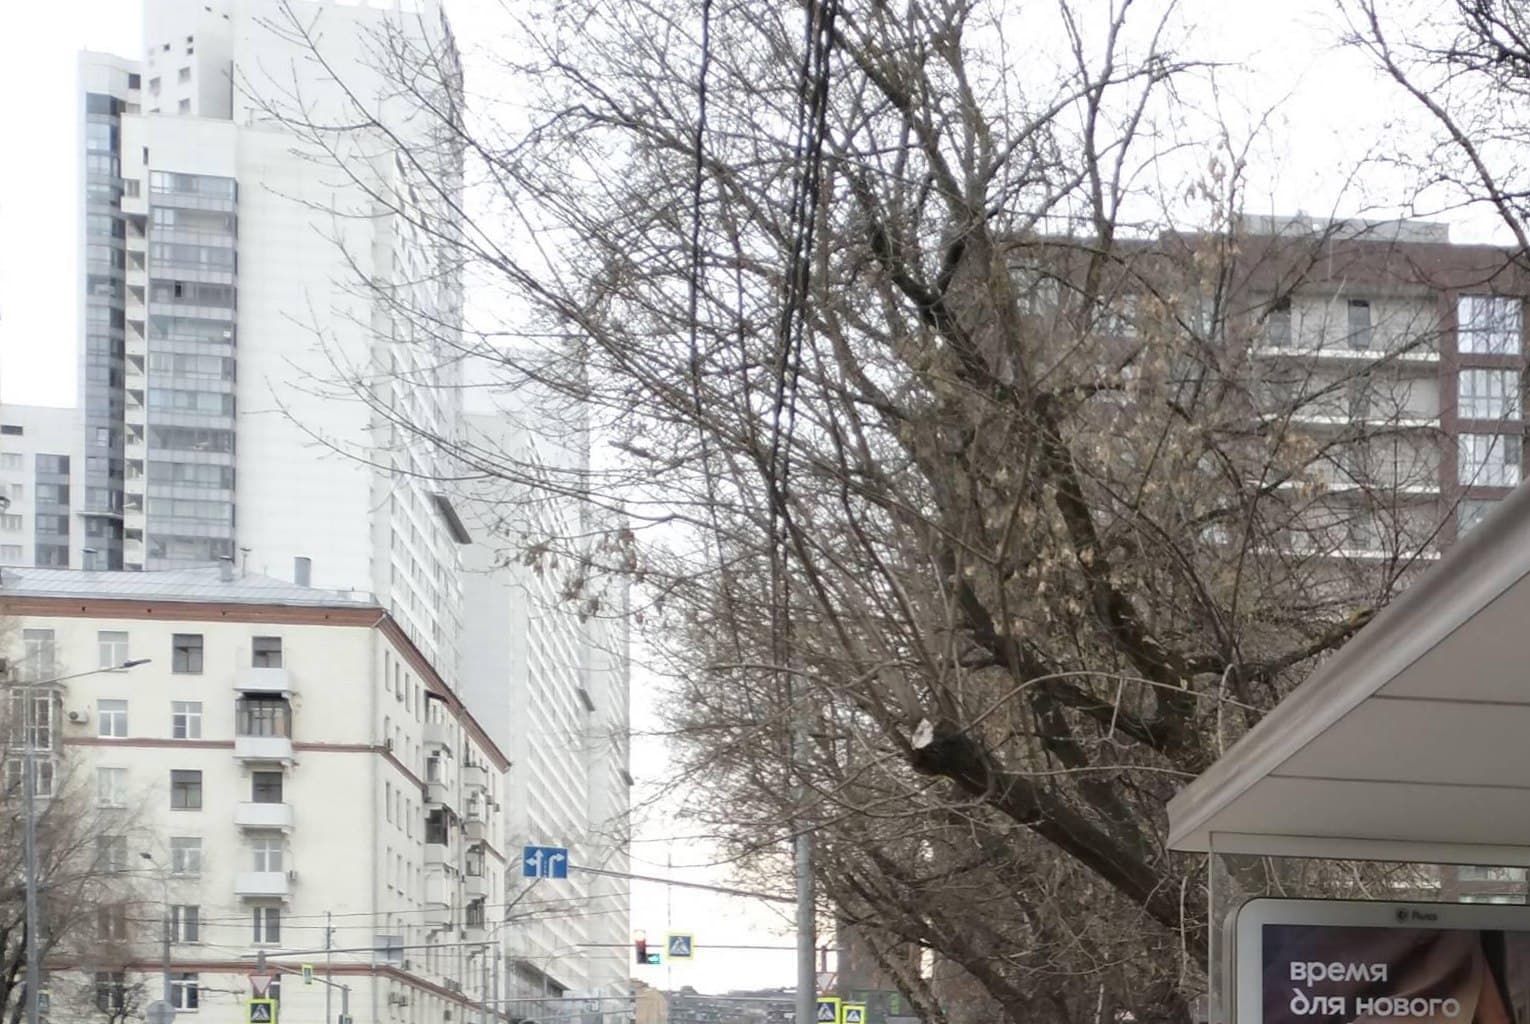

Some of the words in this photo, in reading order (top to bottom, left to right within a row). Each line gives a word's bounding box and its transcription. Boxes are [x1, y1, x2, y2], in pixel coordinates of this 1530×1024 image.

[1289, 961, 1388, 987] время
[1289, 987, 1346, 1016] для
[1355, 997, 1461, 1017] нового
